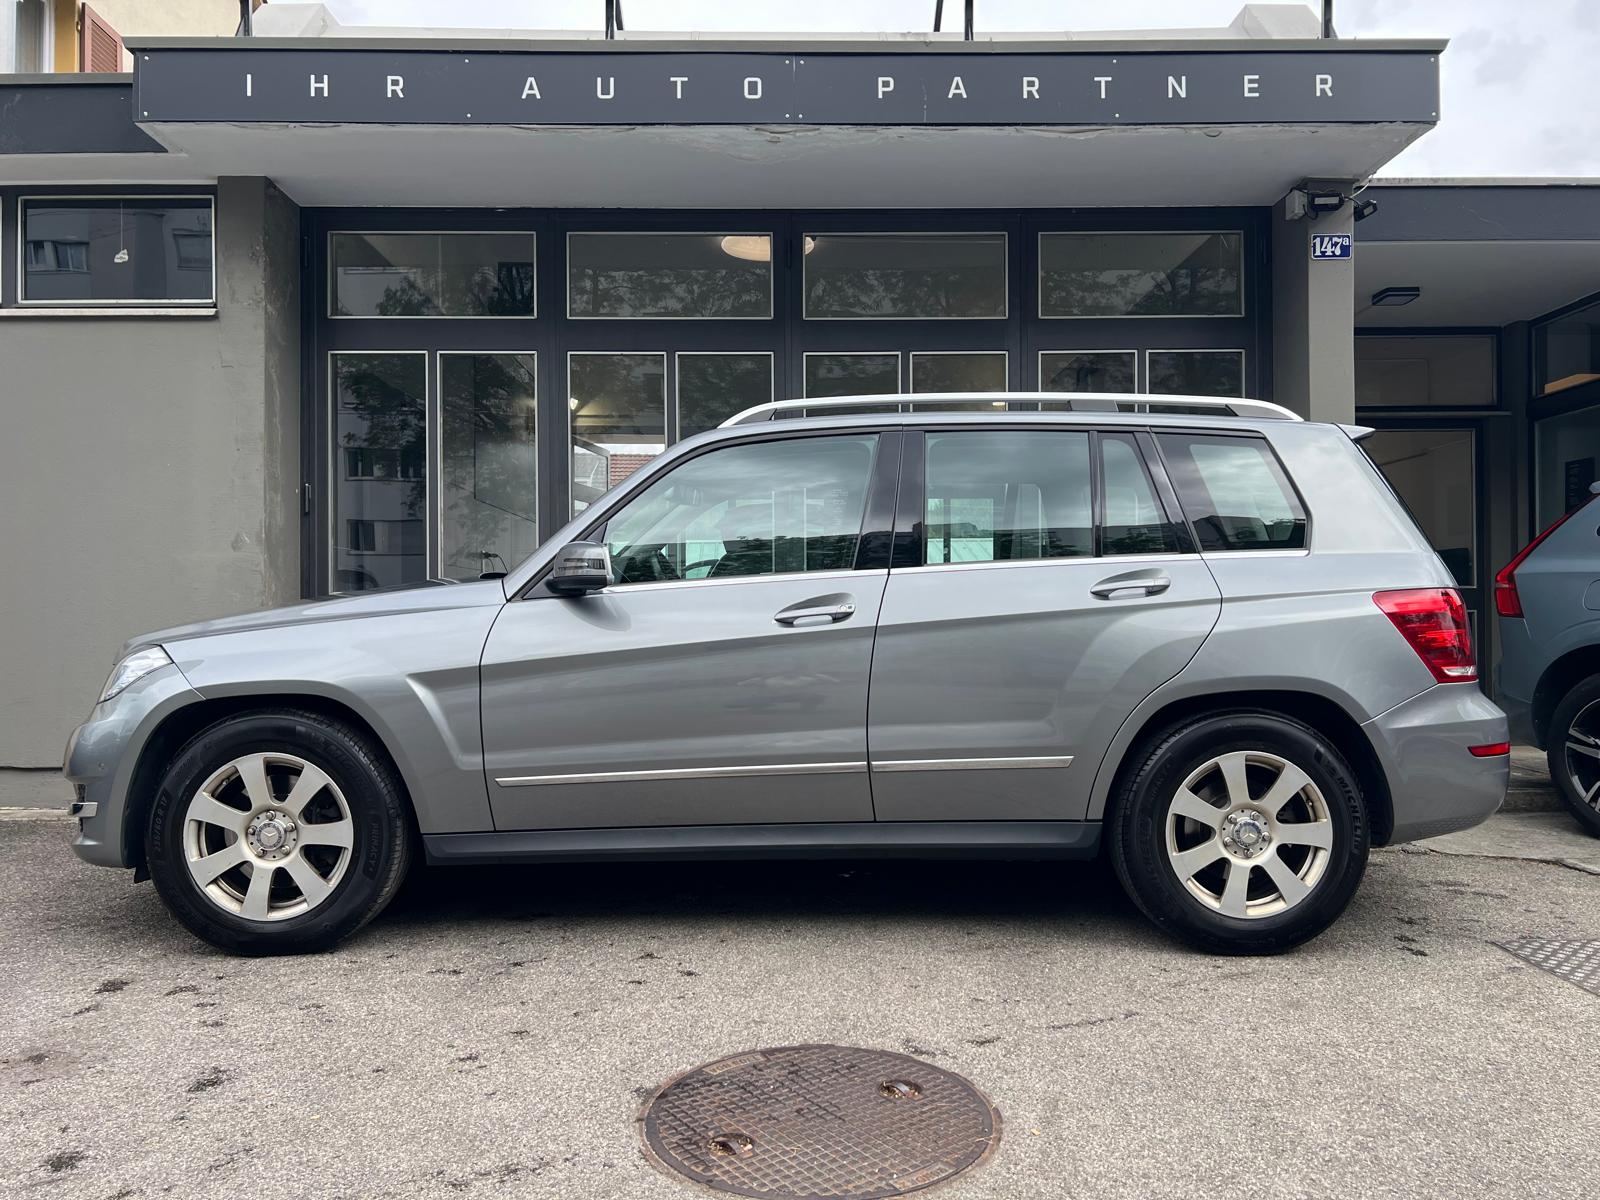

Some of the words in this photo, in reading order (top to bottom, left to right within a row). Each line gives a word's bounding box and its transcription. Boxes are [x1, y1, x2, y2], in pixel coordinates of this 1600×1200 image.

[246, 73, 404, 98] IHR
[521, 76, 763, 100] AUTO
[877, 74, 1334, 100] PARTNER
[1313, 237, 1350, 256] 147a
